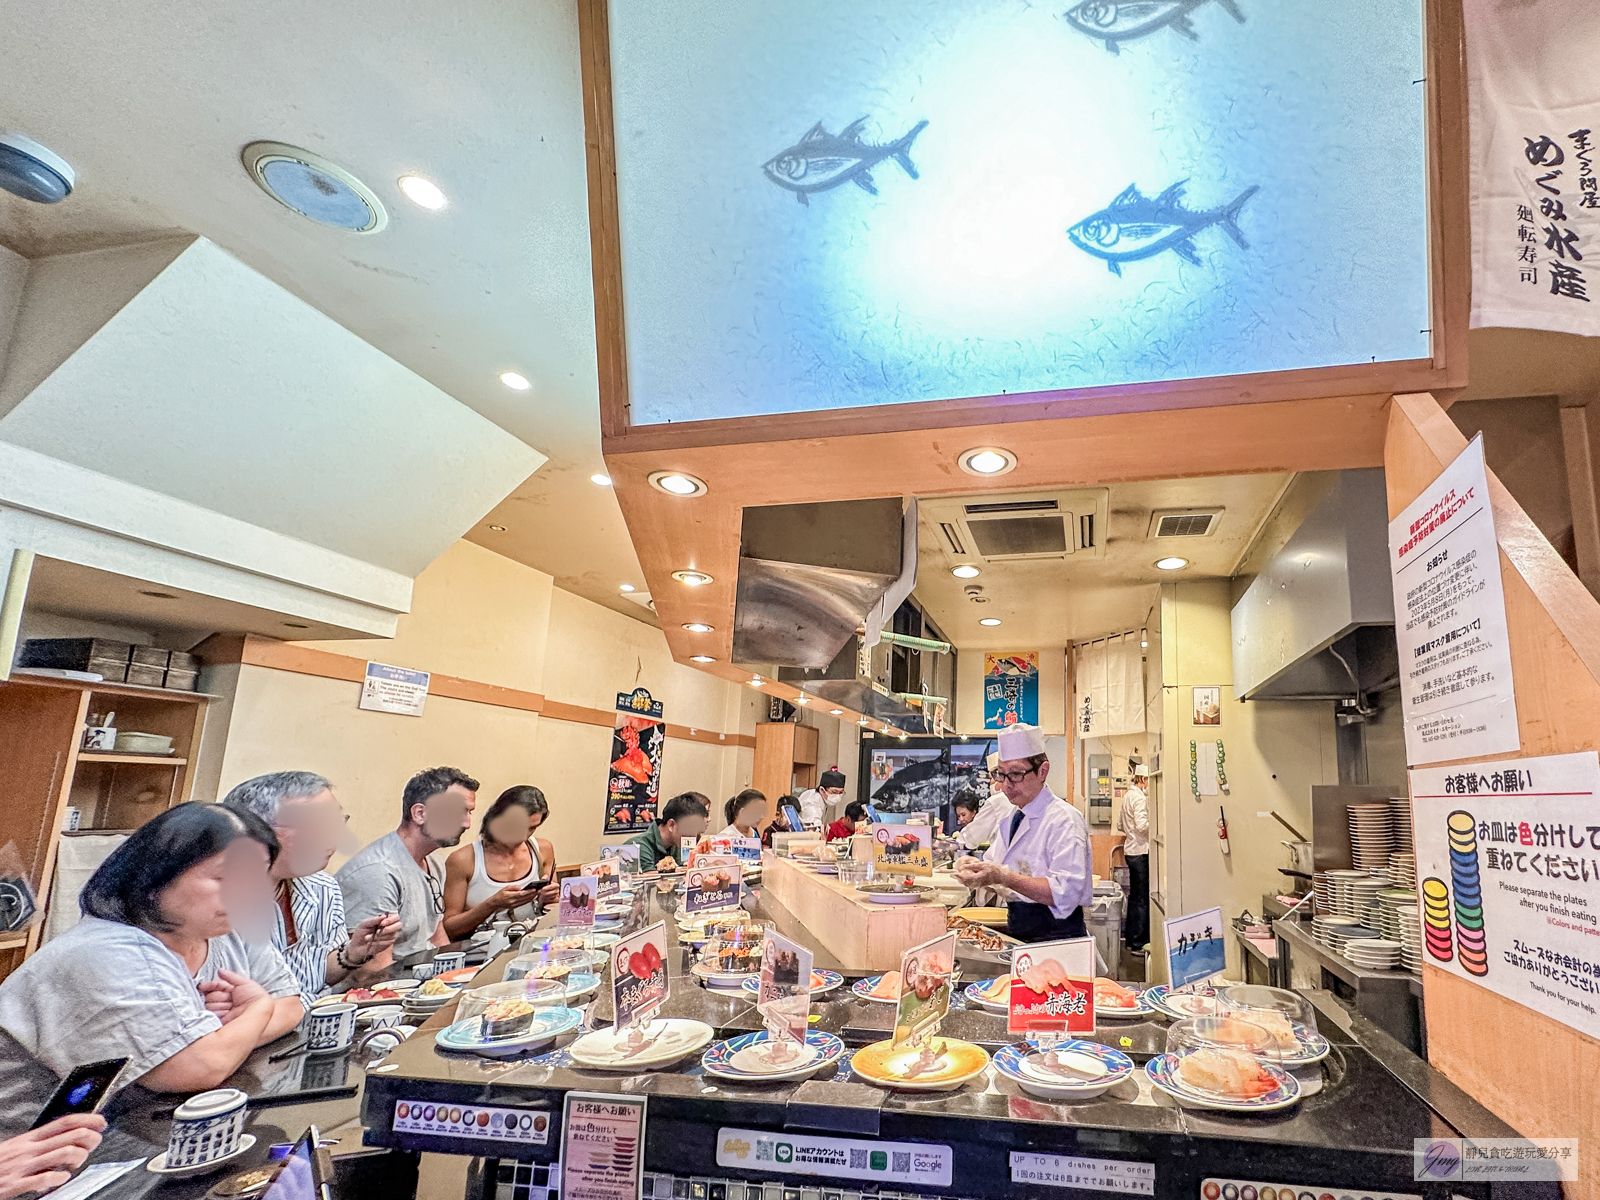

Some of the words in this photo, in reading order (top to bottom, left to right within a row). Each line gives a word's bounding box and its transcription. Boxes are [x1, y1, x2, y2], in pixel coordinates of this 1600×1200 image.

[1523, 135, 1591, 302] めぐみ水産
[1516, 204, 1538, 285] 廻転寿司
[1409, 488, 1456, 536] 新型コロナウイルス
[1426, 548, 1448, 572] お知らせ
[987, 654, 996, 664] 大
[1445, 769, 1533, 794] お客様へお願い
[1478, 820, 1600, 851] お皿は色分けして
[1486, 847, 1600, 882] 重ねてください
[1499, 881, 1519, 893] Please
[1520, 887, 1549, 899] separate
[1549, 890, 1562, 901] the
[1563, 893, 1588, 907] plates
[1519, 897, 1534, 908] after
[1535, 903, 1549, 912] you
[1550, 903, 1570, 917] finish
[1571, 910, 1597, 926] eating
[1571, 924, 1583, 932] and
[1529, 981, 1546, 994] Thank
[1546, 989, 1557, 998] you
[1557, 992, 1566, 1001] for
[1566, 997, 1580, 1007] your
[1580, 1001, 1597, 1015] help.
[576, 1103, 636, 1116] お客様へお願い
[795, 1146, 845, 1157] LINEアカウントは
[913, 1158, 942, 1170] Google
[1013, 1155, 1025, 1163] UP
[1034, 1157, 1046, 1165] TO
[1054, 1159, 1060, 1167] 6
[1068, 1161, 1096, 1170] dishes
[1104, 1164, 1118, 1172] per
[1127, 1166, 1151, 1174] order
